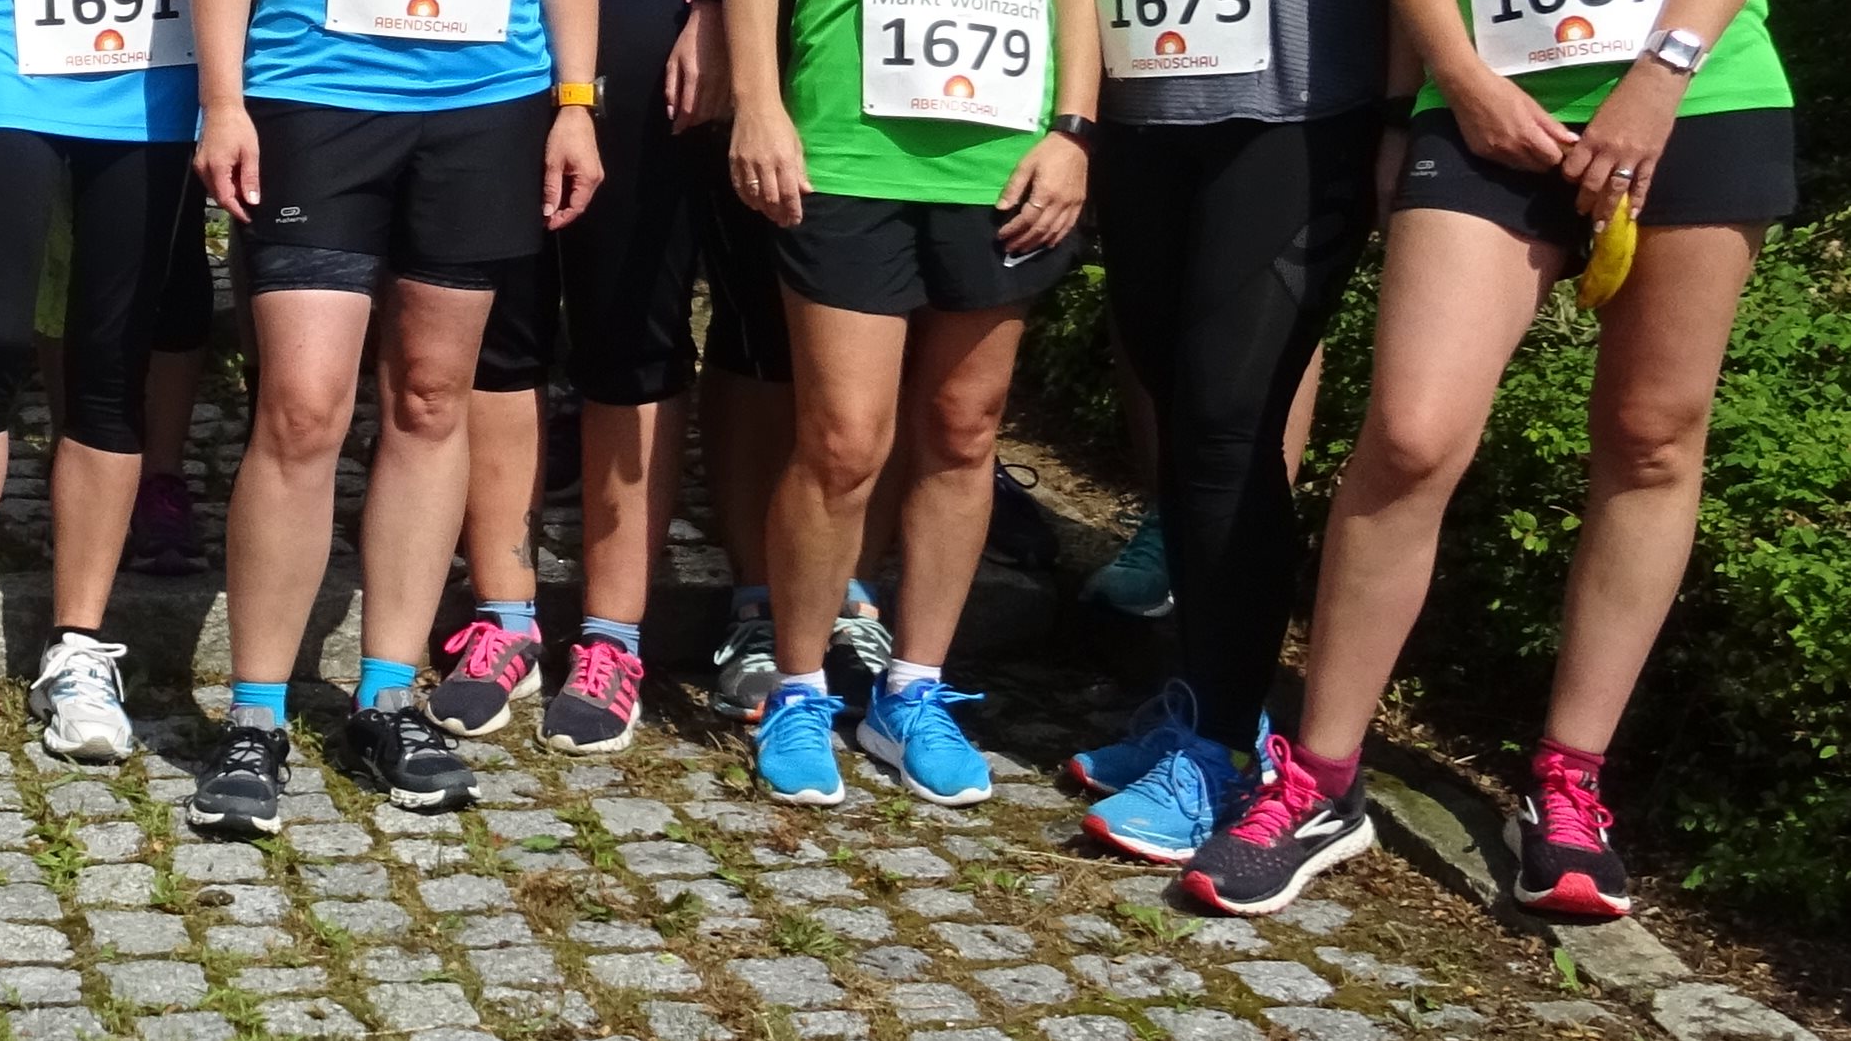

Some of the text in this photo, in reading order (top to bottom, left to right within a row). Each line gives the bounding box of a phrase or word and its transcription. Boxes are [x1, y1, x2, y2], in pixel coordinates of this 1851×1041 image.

[375, 16, 468, 33] ABENDSCHAU
[882, 18, 1031, 77] 1679
[1528, 40, 1634, 63] ABENDSCHAU
[65, 51, 153, 67] ABENDSCHAU
[1132, 56, 1219, 70] ABENDSCHAU
[911, 98, 998, 117] ABENDSCHAU
